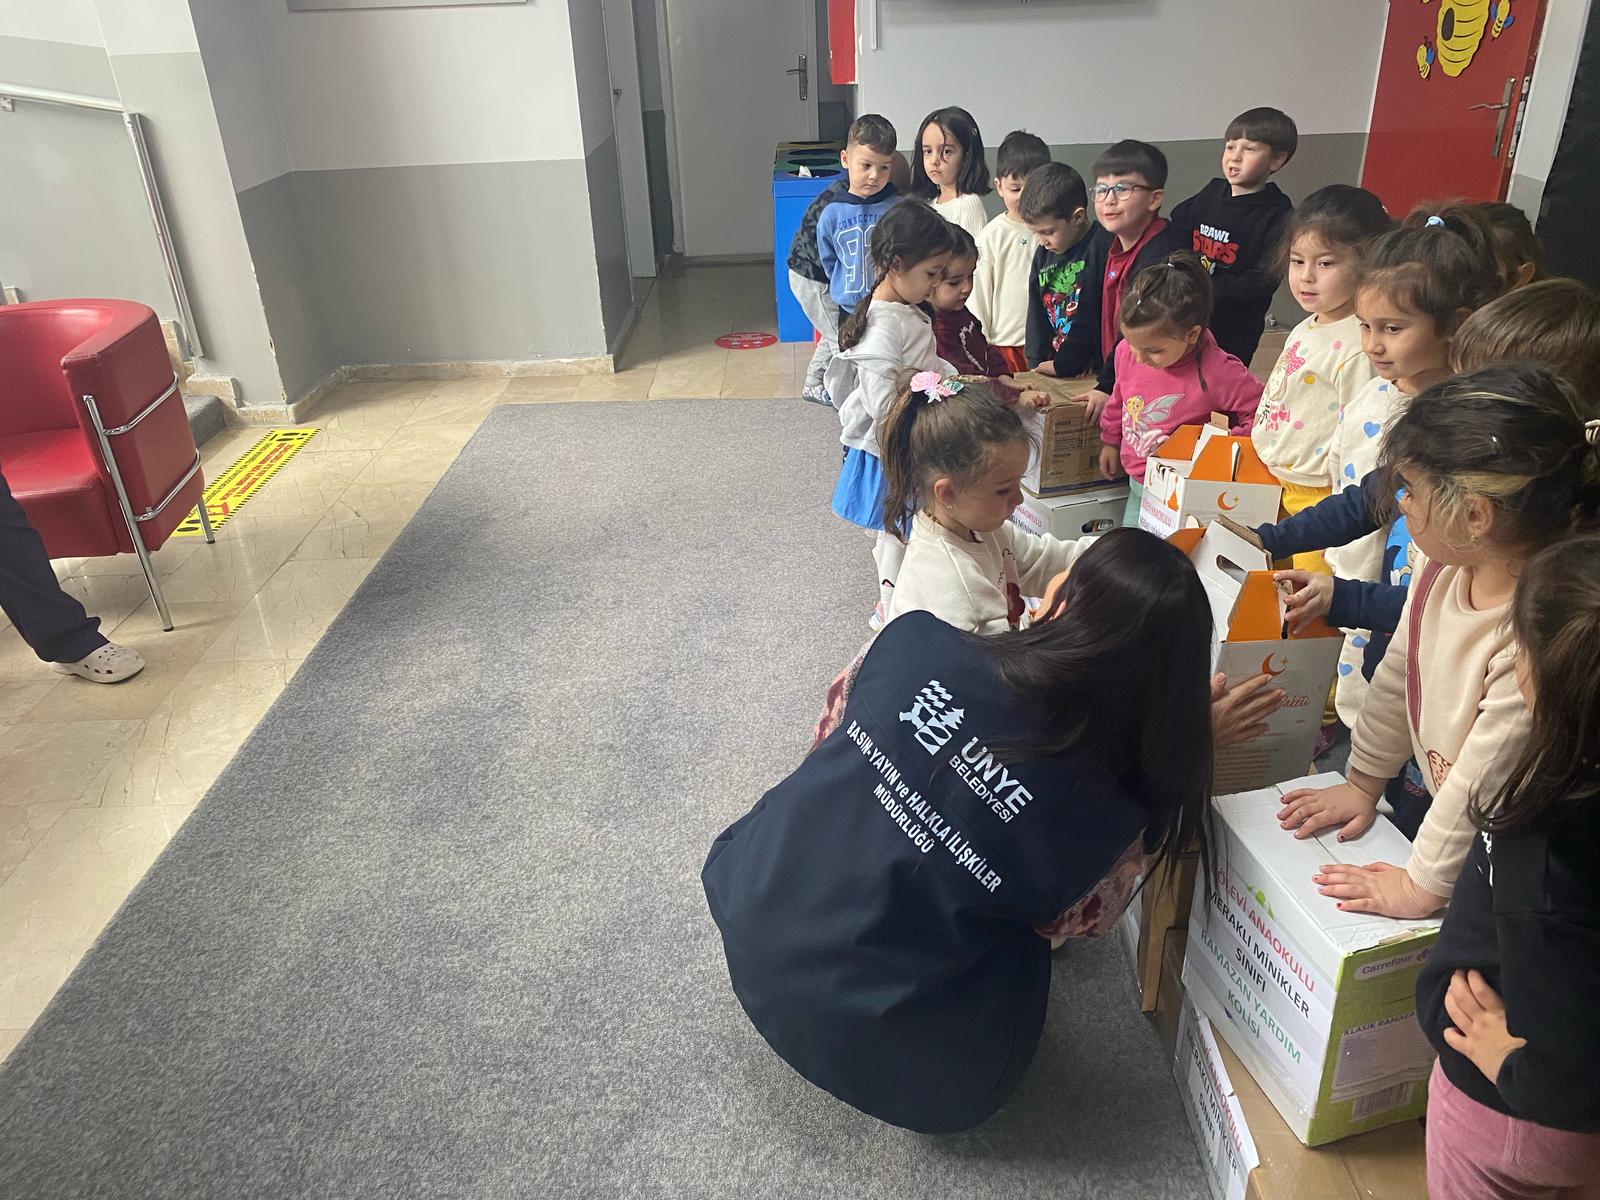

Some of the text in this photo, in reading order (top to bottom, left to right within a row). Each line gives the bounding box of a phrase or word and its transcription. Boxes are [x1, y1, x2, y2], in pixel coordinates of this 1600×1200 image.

[838, 213, 882, 230] CONNECTI
[1192, 230, 1240, 264] STARS
[1200, 223, 1230, 243] BRAWL
[846, 720, 1002, 893] BASIN-YAYIN ve HALKLA İLİŞKİLER
[949, 755, 1013, 823] BELEDİYESİ
[960, 737, 1033, 815] ÜNYE
[873, 782, 935, 854] MÜDÜRLÜĞÜ
[1209, 889, 1310, 1019] MERAKLI MİNİKLER
[1212, 865, 1315, 993] ÖLEVİ ANAOKULU
[1201, 929, 1301, 1064] RAMAZAN YARDIM
[1235, 947, 1266, 993] SINIFI
[1362, 952, 1414, 976] Carrefour
[1228, 989, 1260, 1039] KOLİSİ
[1377, 1011, 1416, 1027] RAMAZA
[1209, 1062, 1242, 1152] ANAOKULU
